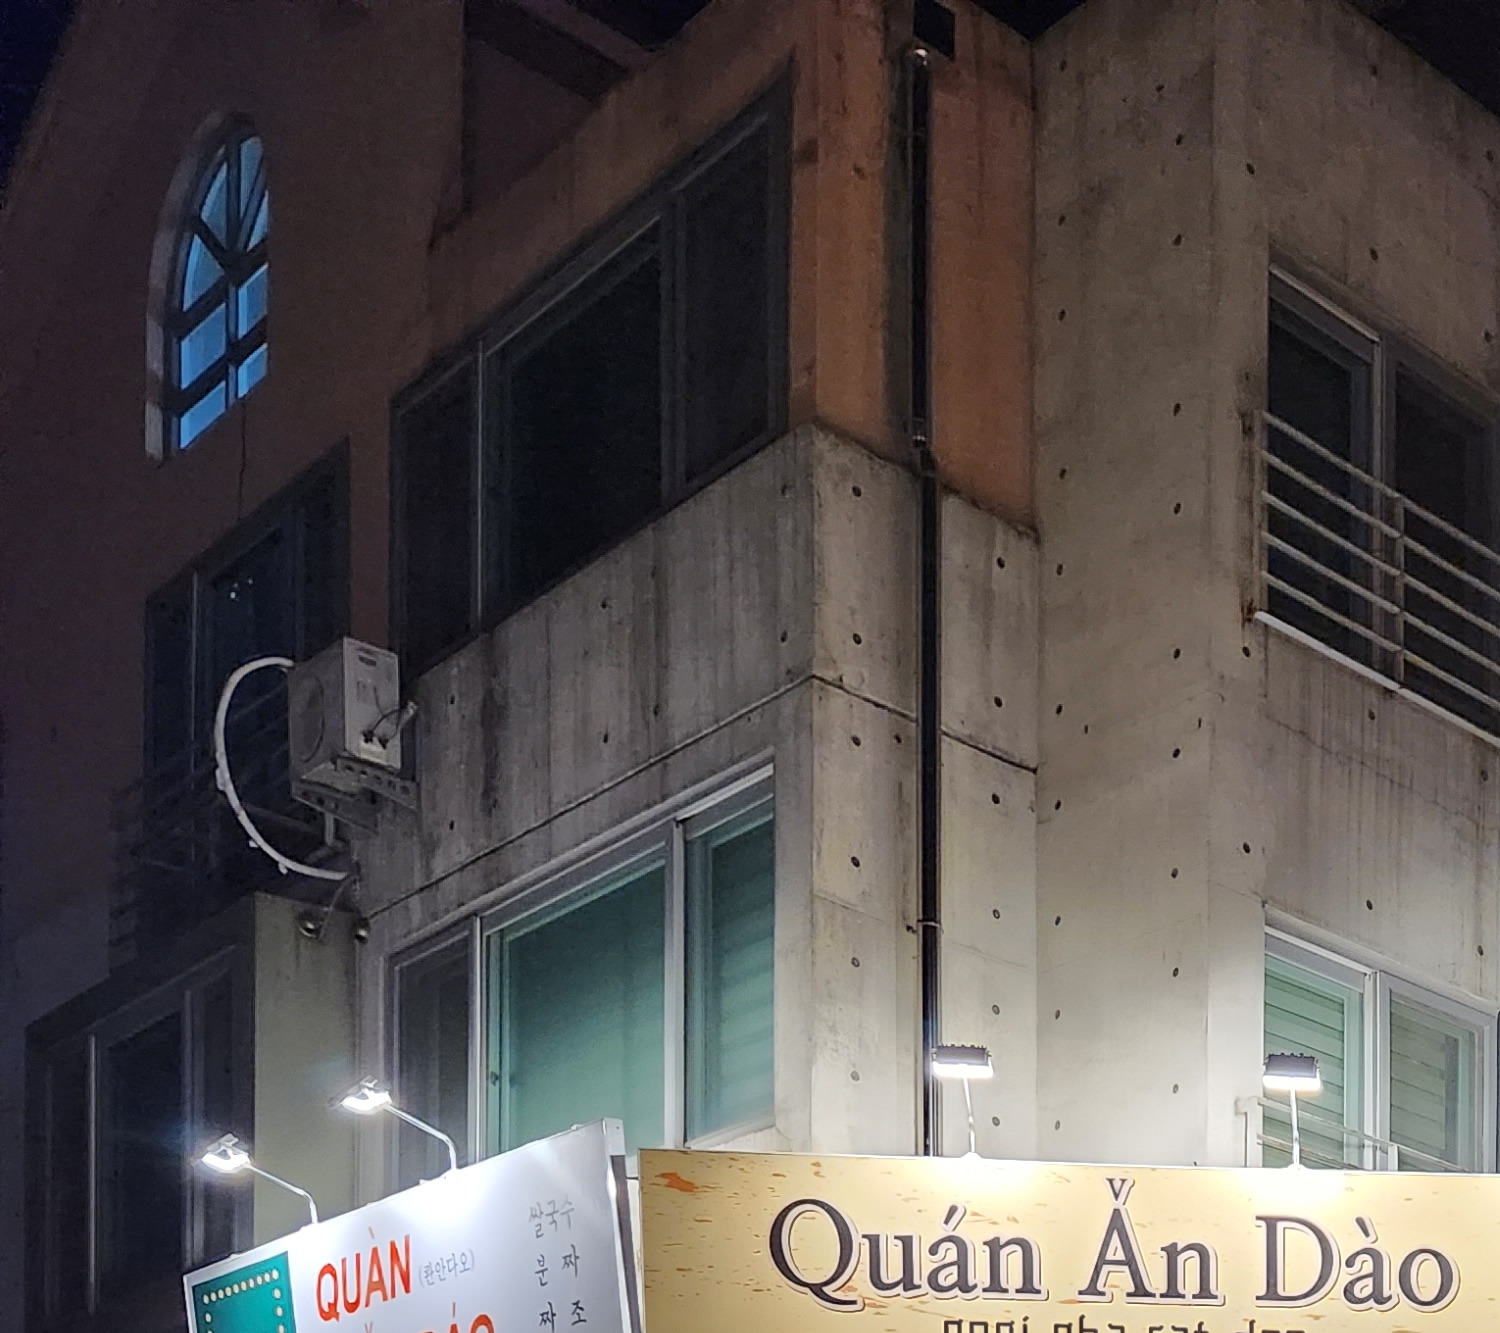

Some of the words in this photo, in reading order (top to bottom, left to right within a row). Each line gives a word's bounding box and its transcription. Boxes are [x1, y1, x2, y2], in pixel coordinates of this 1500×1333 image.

[529, 1194, 575, 1239] 쌀국수
[769, 1197, 1049, 1312] Quán
[1255, 1214, 1461, 1314] Dào
